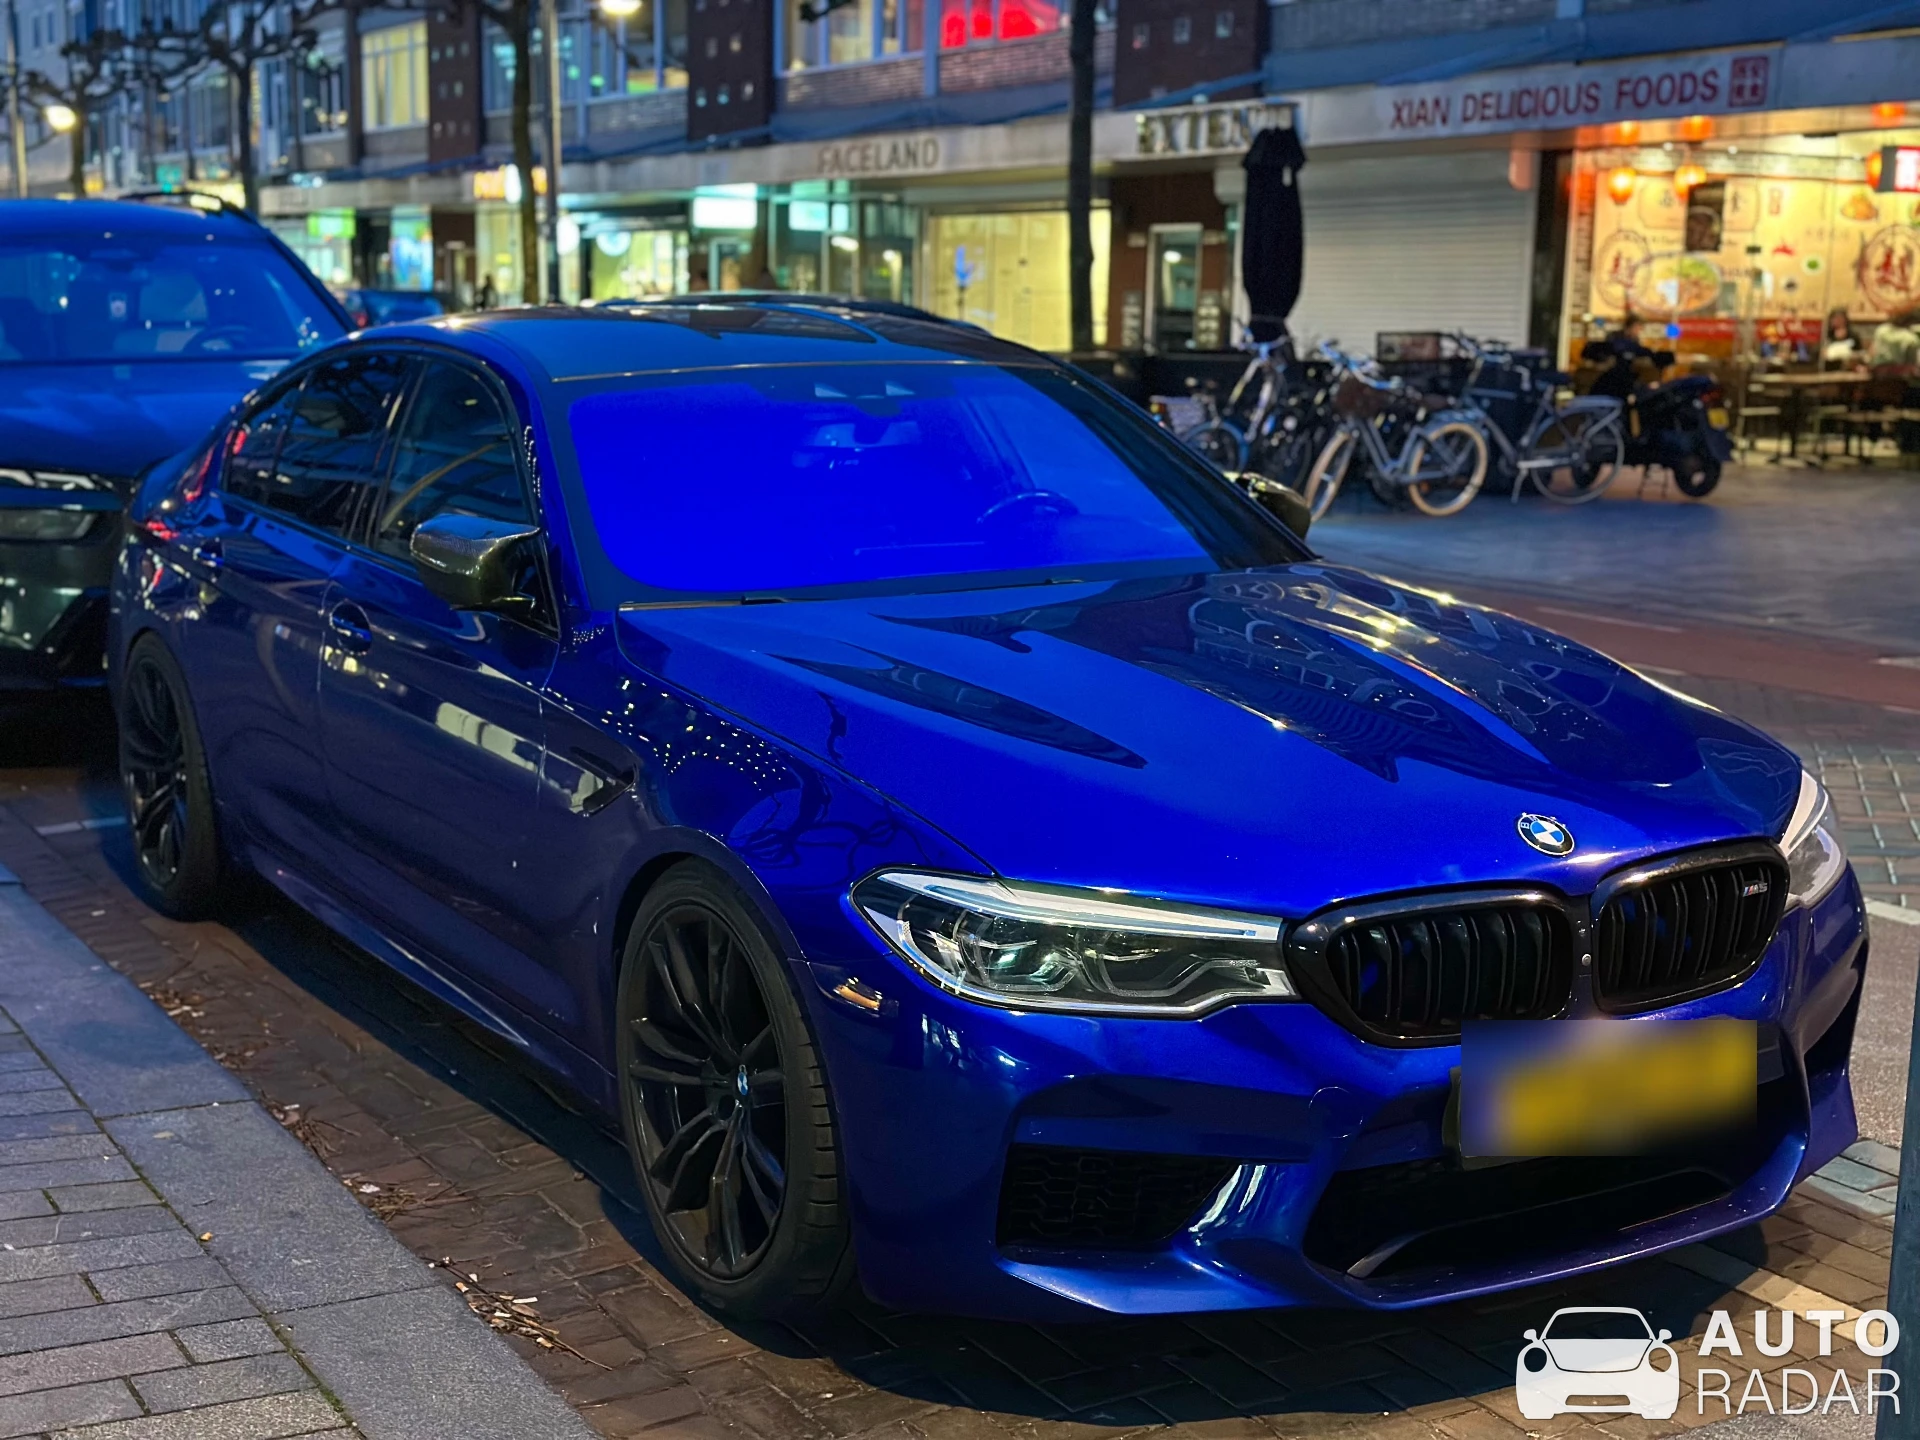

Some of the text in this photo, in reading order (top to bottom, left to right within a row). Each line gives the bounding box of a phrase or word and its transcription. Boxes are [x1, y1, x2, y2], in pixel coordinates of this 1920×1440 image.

[1391, 97, 1449, 128] XIAN
[1462, 82, 1600, 122] DELICIOUS
[1616, 69, 1719, 110] FOODS
[816, 138, 939, 174] FACELAND
